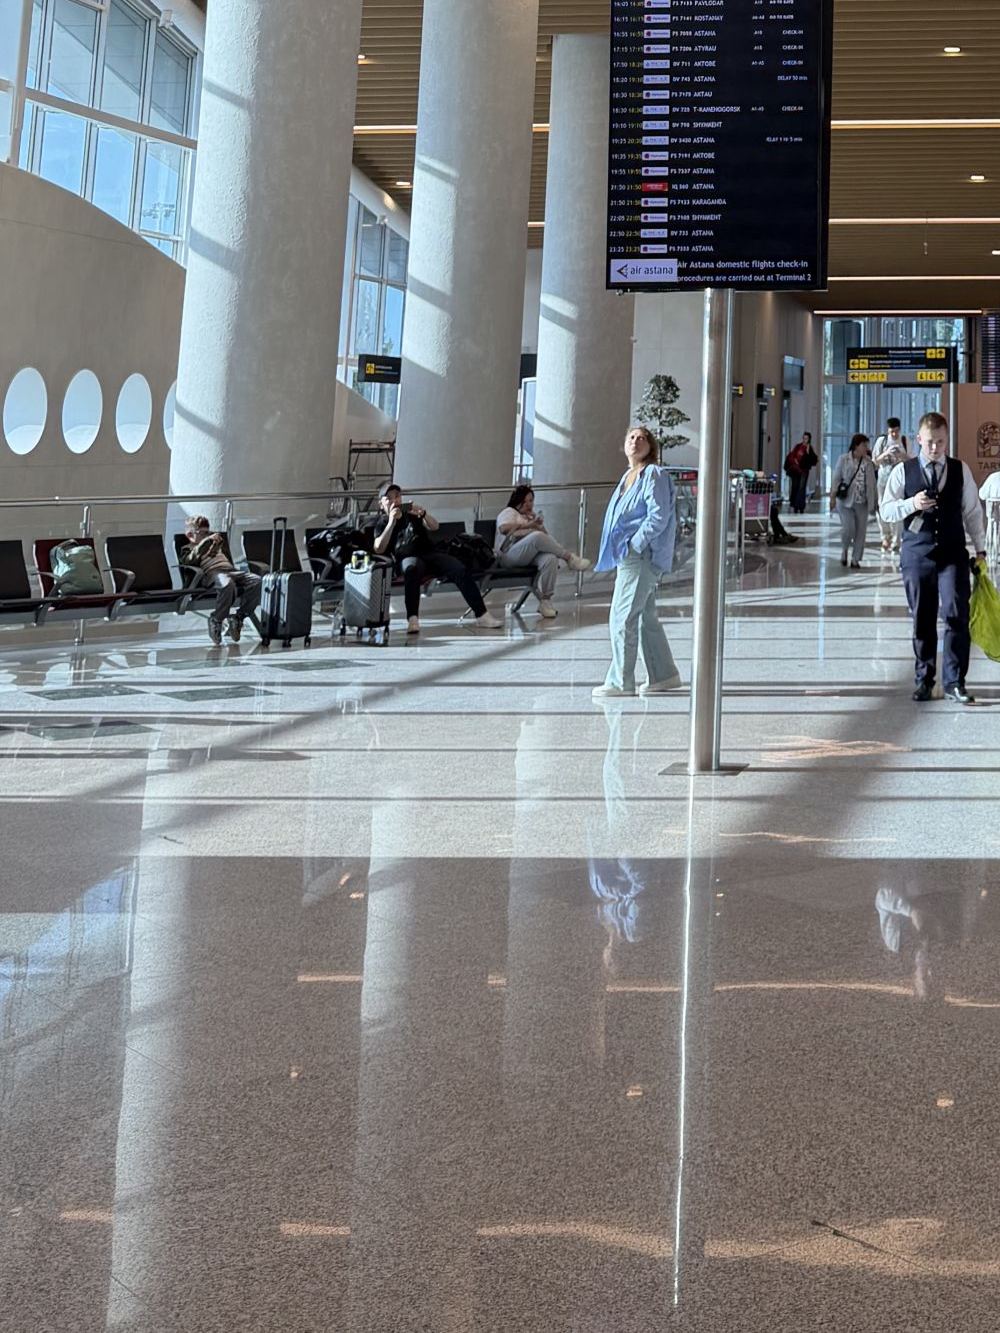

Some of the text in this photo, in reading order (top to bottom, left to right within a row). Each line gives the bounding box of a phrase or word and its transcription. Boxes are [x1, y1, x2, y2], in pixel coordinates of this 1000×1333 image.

[694, 0, 724, 7] PAVLODAR
[694, 14, 724, 22] KOSTANAY
[693, 75, 716, 83] ASTANA
[692, 136, 715, 144] ASTANA
[691, 244, 714, 252] ASTANA
[752, 261, 775, 269] flights
[777, 260, 808, 268] check-in
[630, 266, 673, 275] air astana
[677, 275, 714, 283] procedures
[728, 274, 752, 282] carried
[775, 273, 806, 281] Terminal
